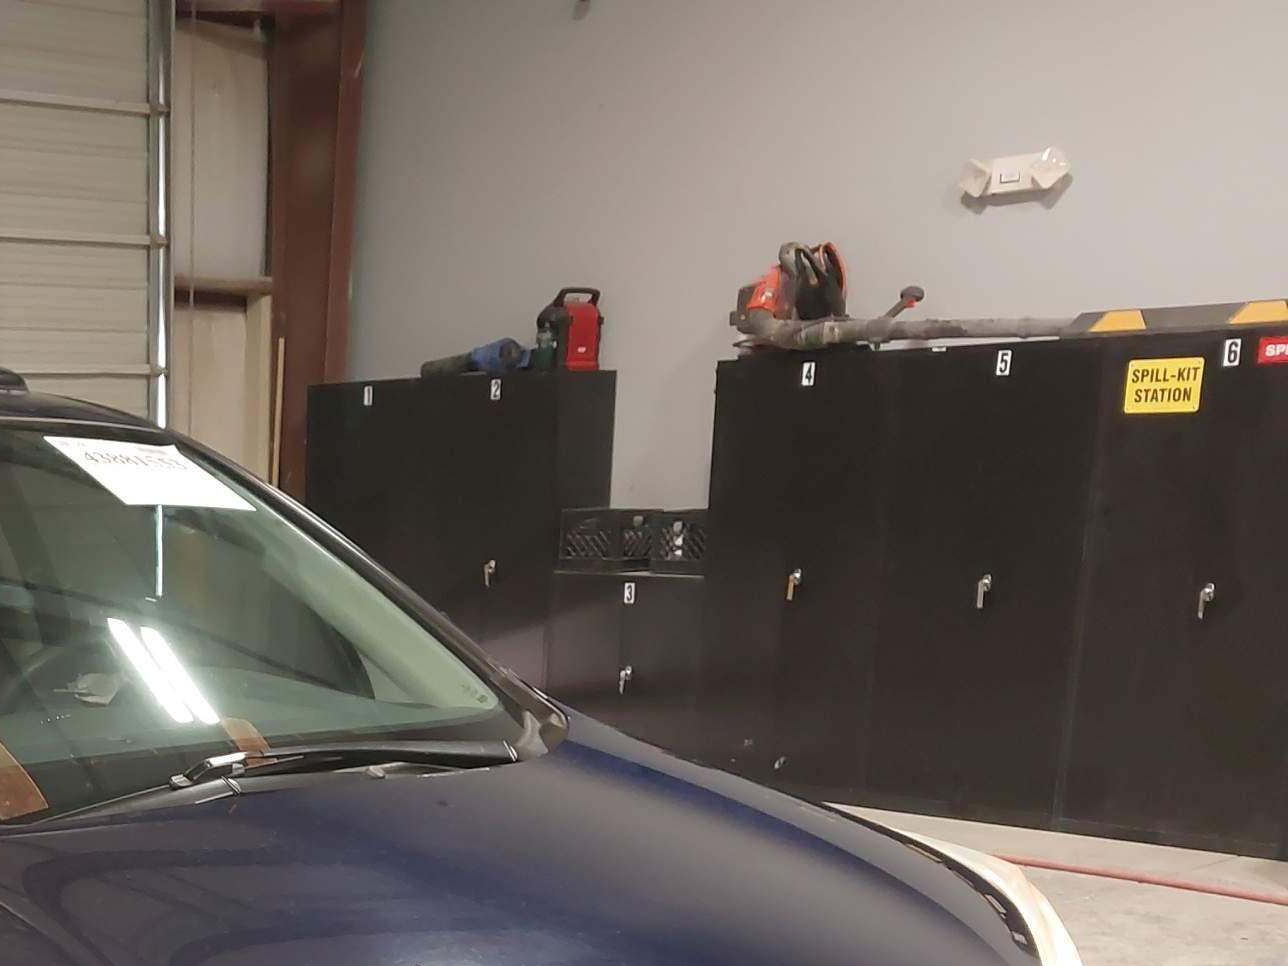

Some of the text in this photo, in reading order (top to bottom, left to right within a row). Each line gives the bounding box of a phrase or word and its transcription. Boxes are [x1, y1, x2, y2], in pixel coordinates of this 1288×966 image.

[1227, 341, 1239, 364] 6
[999, 353, 1009, 373] 5
[804, 364, 813, 384] 4
[1131, 367, 1200, 383] SPILL-KIT
[492, 380, 500, 399] 2
[1134, 387, 1192, 403] STATION
[625, 584, 633, 602] 3
